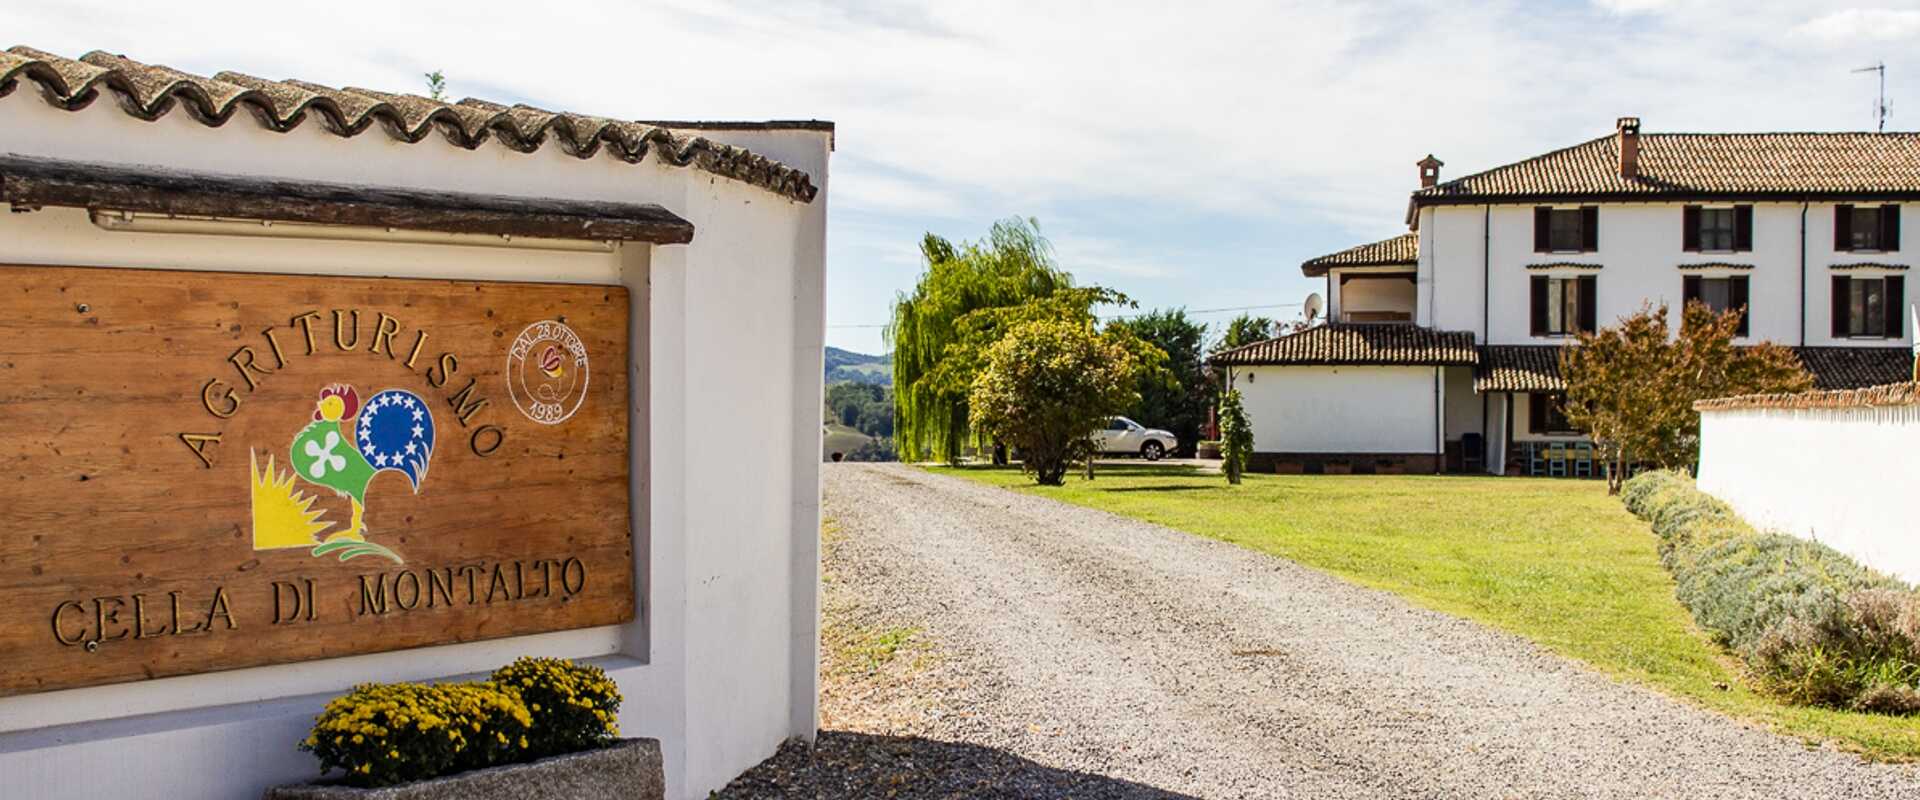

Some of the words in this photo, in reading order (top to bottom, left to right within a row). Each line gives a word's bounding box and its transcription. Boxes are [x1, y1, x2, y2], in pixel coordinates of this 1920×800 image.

[512, 332, 537, 361] DAL
[536, 324, 550, 339] 28
[551, 325, 586, 368] OTTOBRE
[178, 308, 505, 469] AGRITURISMO
[529, 401, 563, 421] 1989
[51, 586, 238, 647] CELLA
[271, 577, 319, 625] DI
[358, 556, 587, 616] MONTALTO
